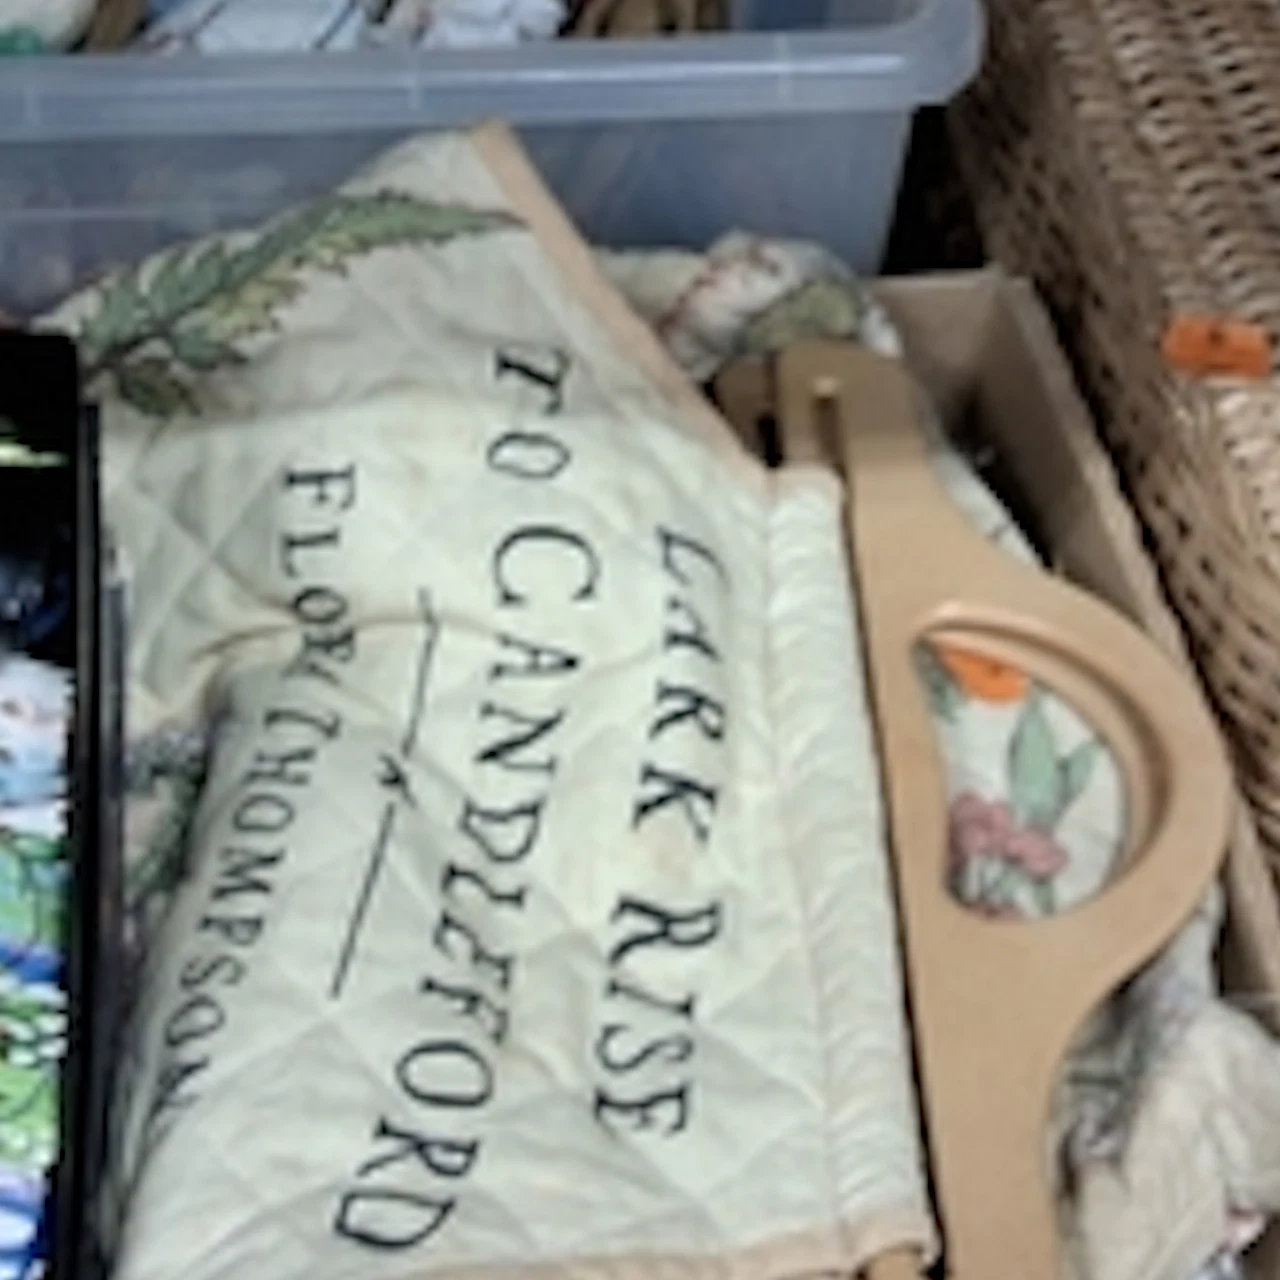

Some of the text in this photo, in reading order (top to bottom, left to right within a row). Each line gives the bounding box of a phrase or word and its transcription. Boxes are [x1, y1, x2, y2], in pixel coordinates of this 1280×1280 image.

[148, 707, 343, 1123] THOMPSON
[333, 347, 601, 1250] TO CANDLEFORD
[595, 528, 726, 1141] LARK RISE
